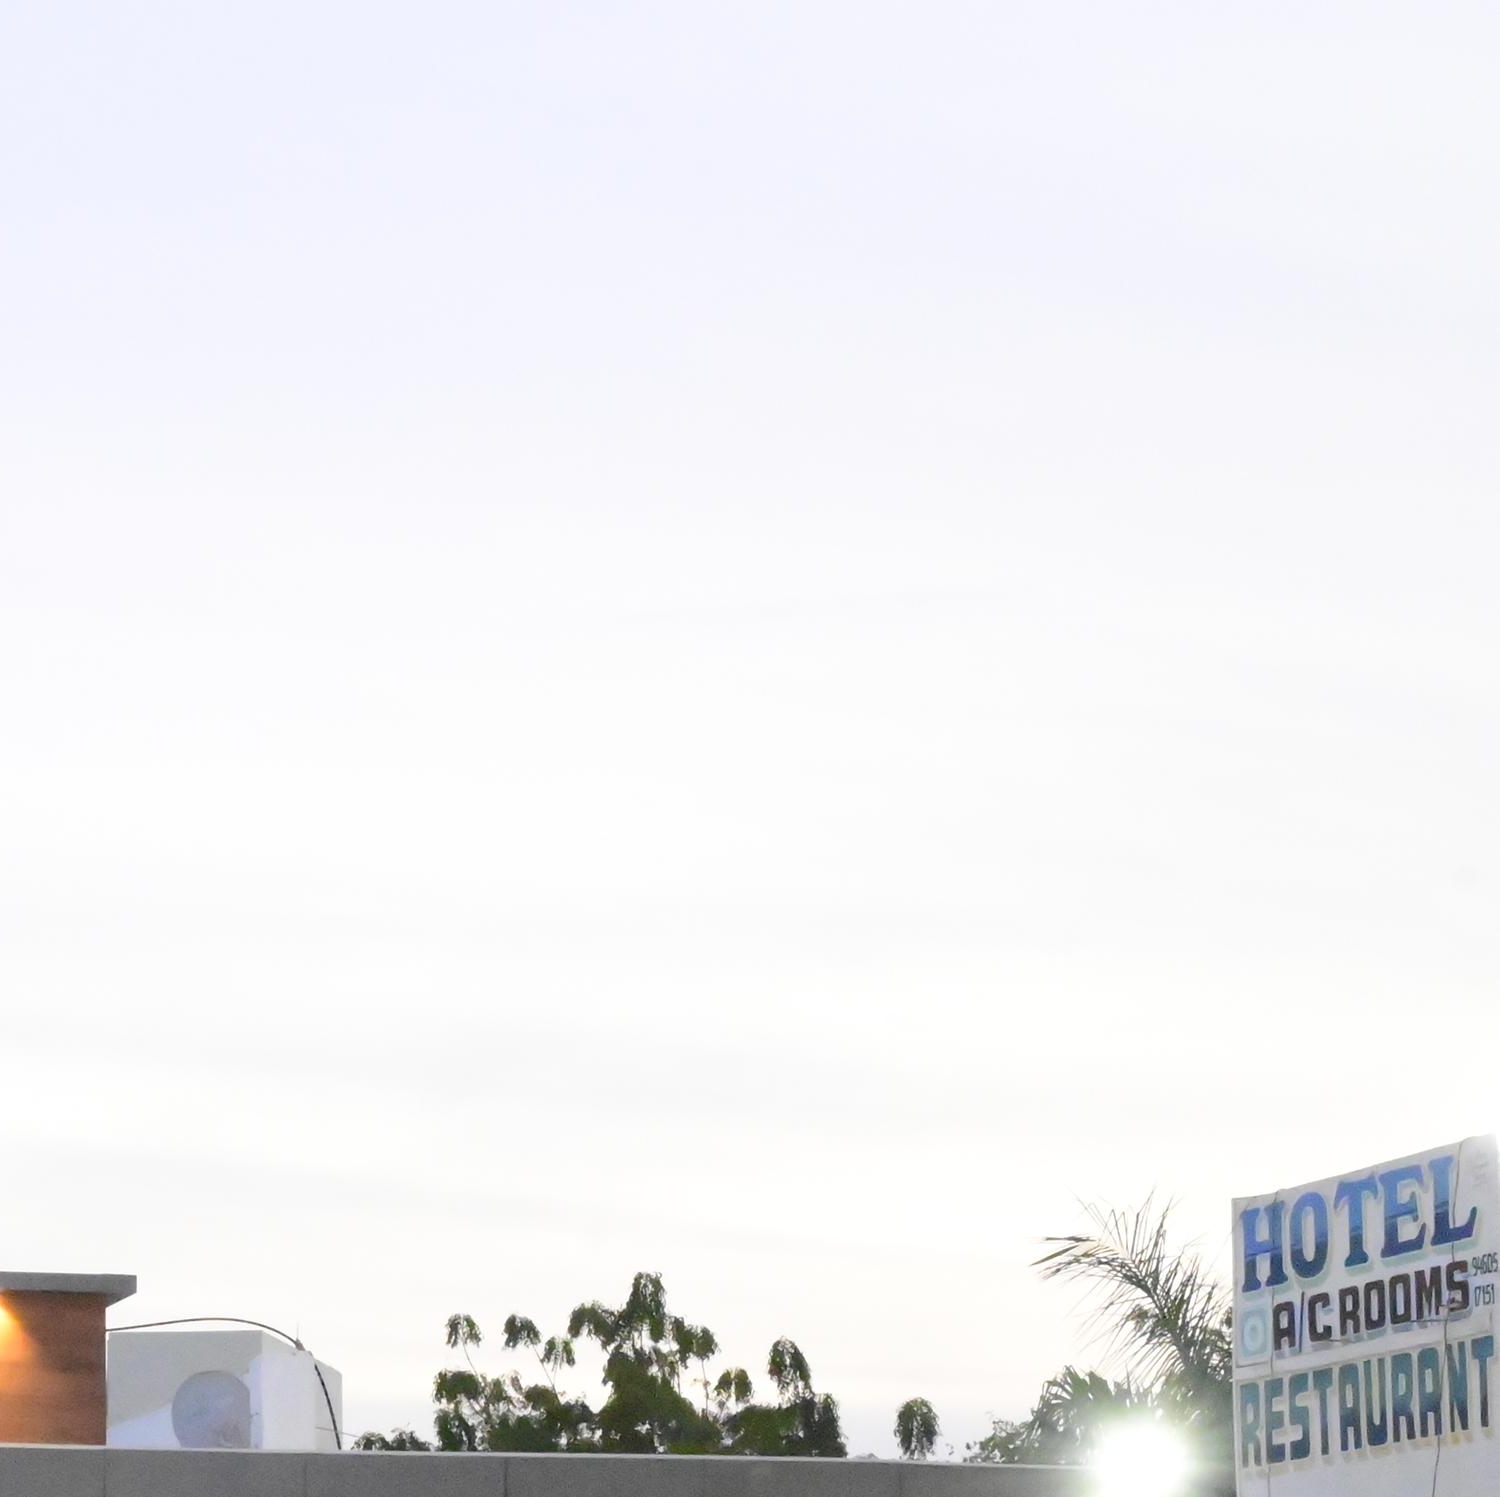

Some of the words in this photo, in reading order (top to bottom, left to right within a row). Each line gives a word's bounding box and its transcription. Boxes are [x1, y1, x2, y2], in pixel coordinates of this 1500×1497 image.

[1239, 1155, 1478, 1293] HOTEL
[1338, 1259, 1470, 1337] ROOMS
[1239, 1335, 1495, 1469] RESTAURANT
